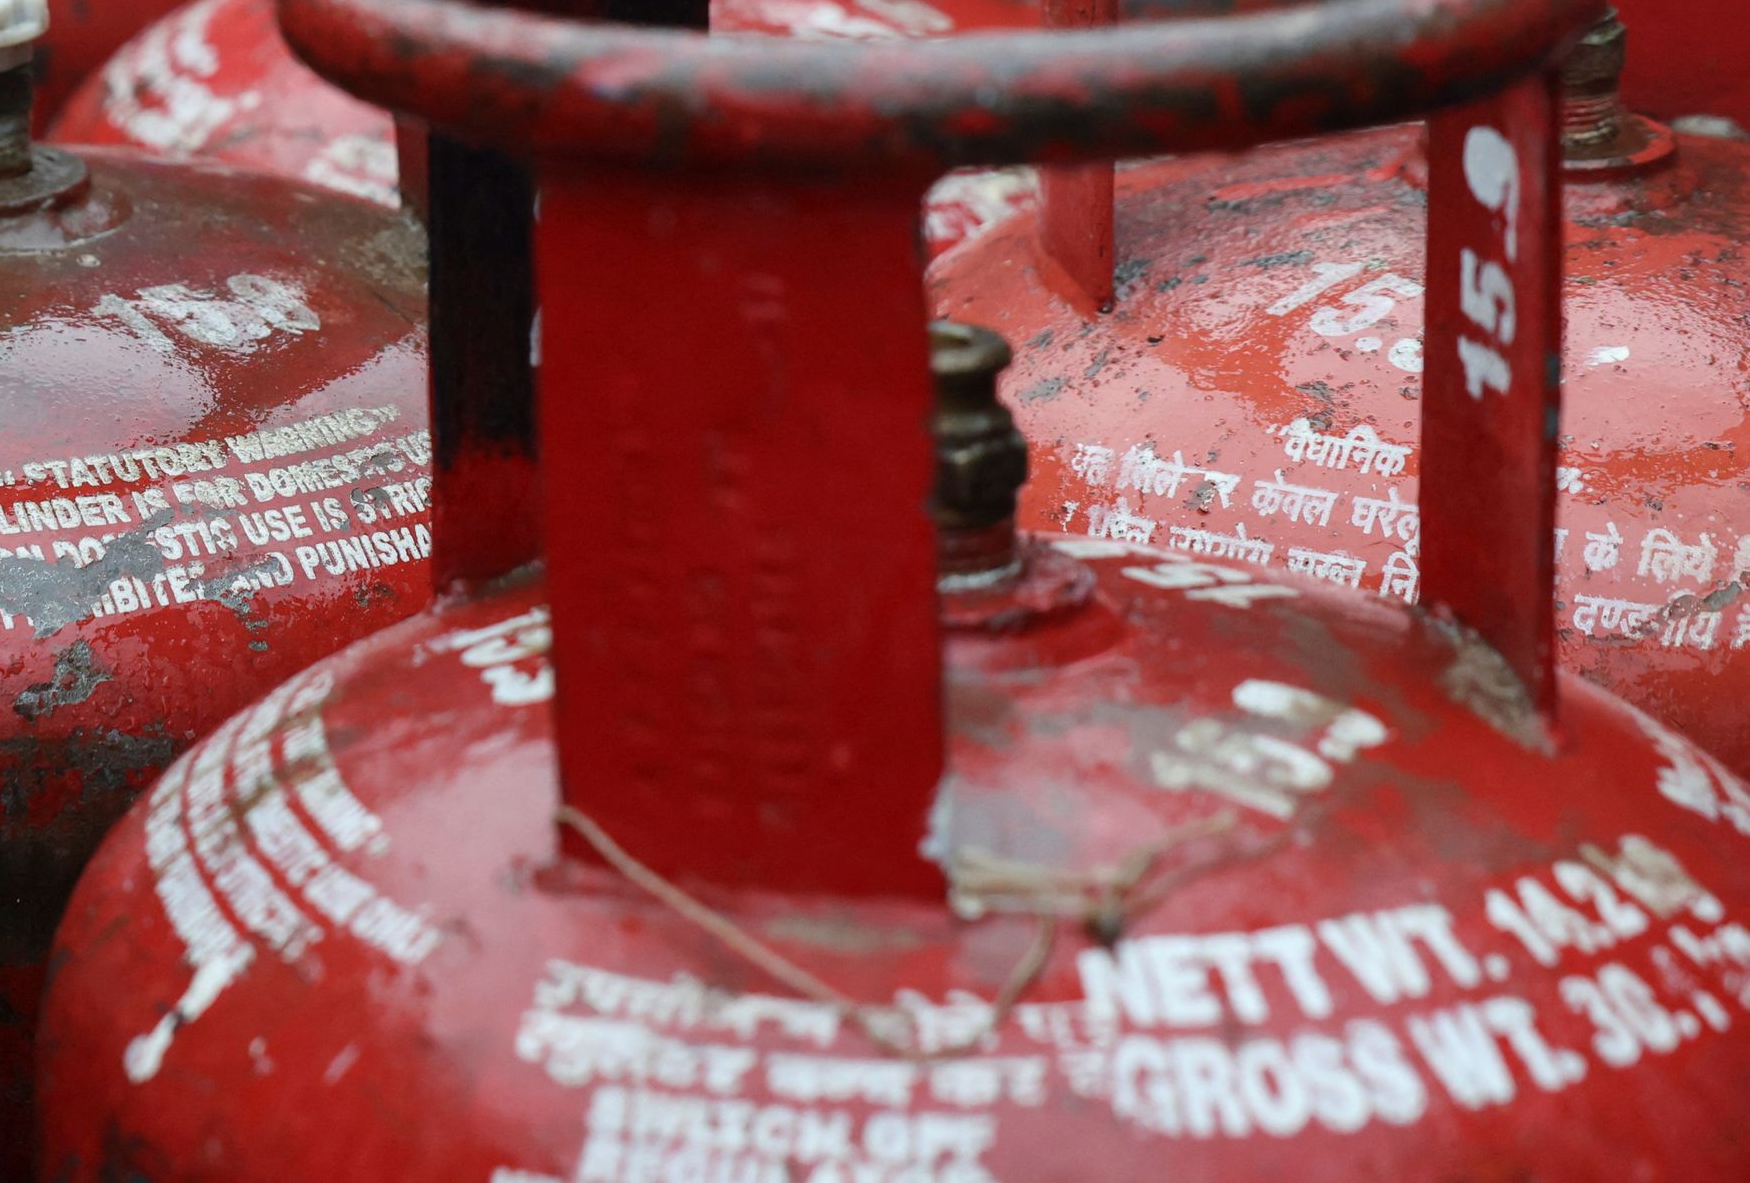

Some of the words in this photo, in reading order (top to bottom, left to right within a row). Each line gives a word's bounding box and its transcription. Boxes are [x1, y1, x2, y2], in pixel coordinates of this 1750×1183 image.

[171, 474, 250, 512] FOR
[238, 504, 314, 546] USE
[294, 520, 433, 581] PUNISHA
[1076, 922, 1335, 1029] NETT
[1110, 1018, 1430, 1140] GROSS
